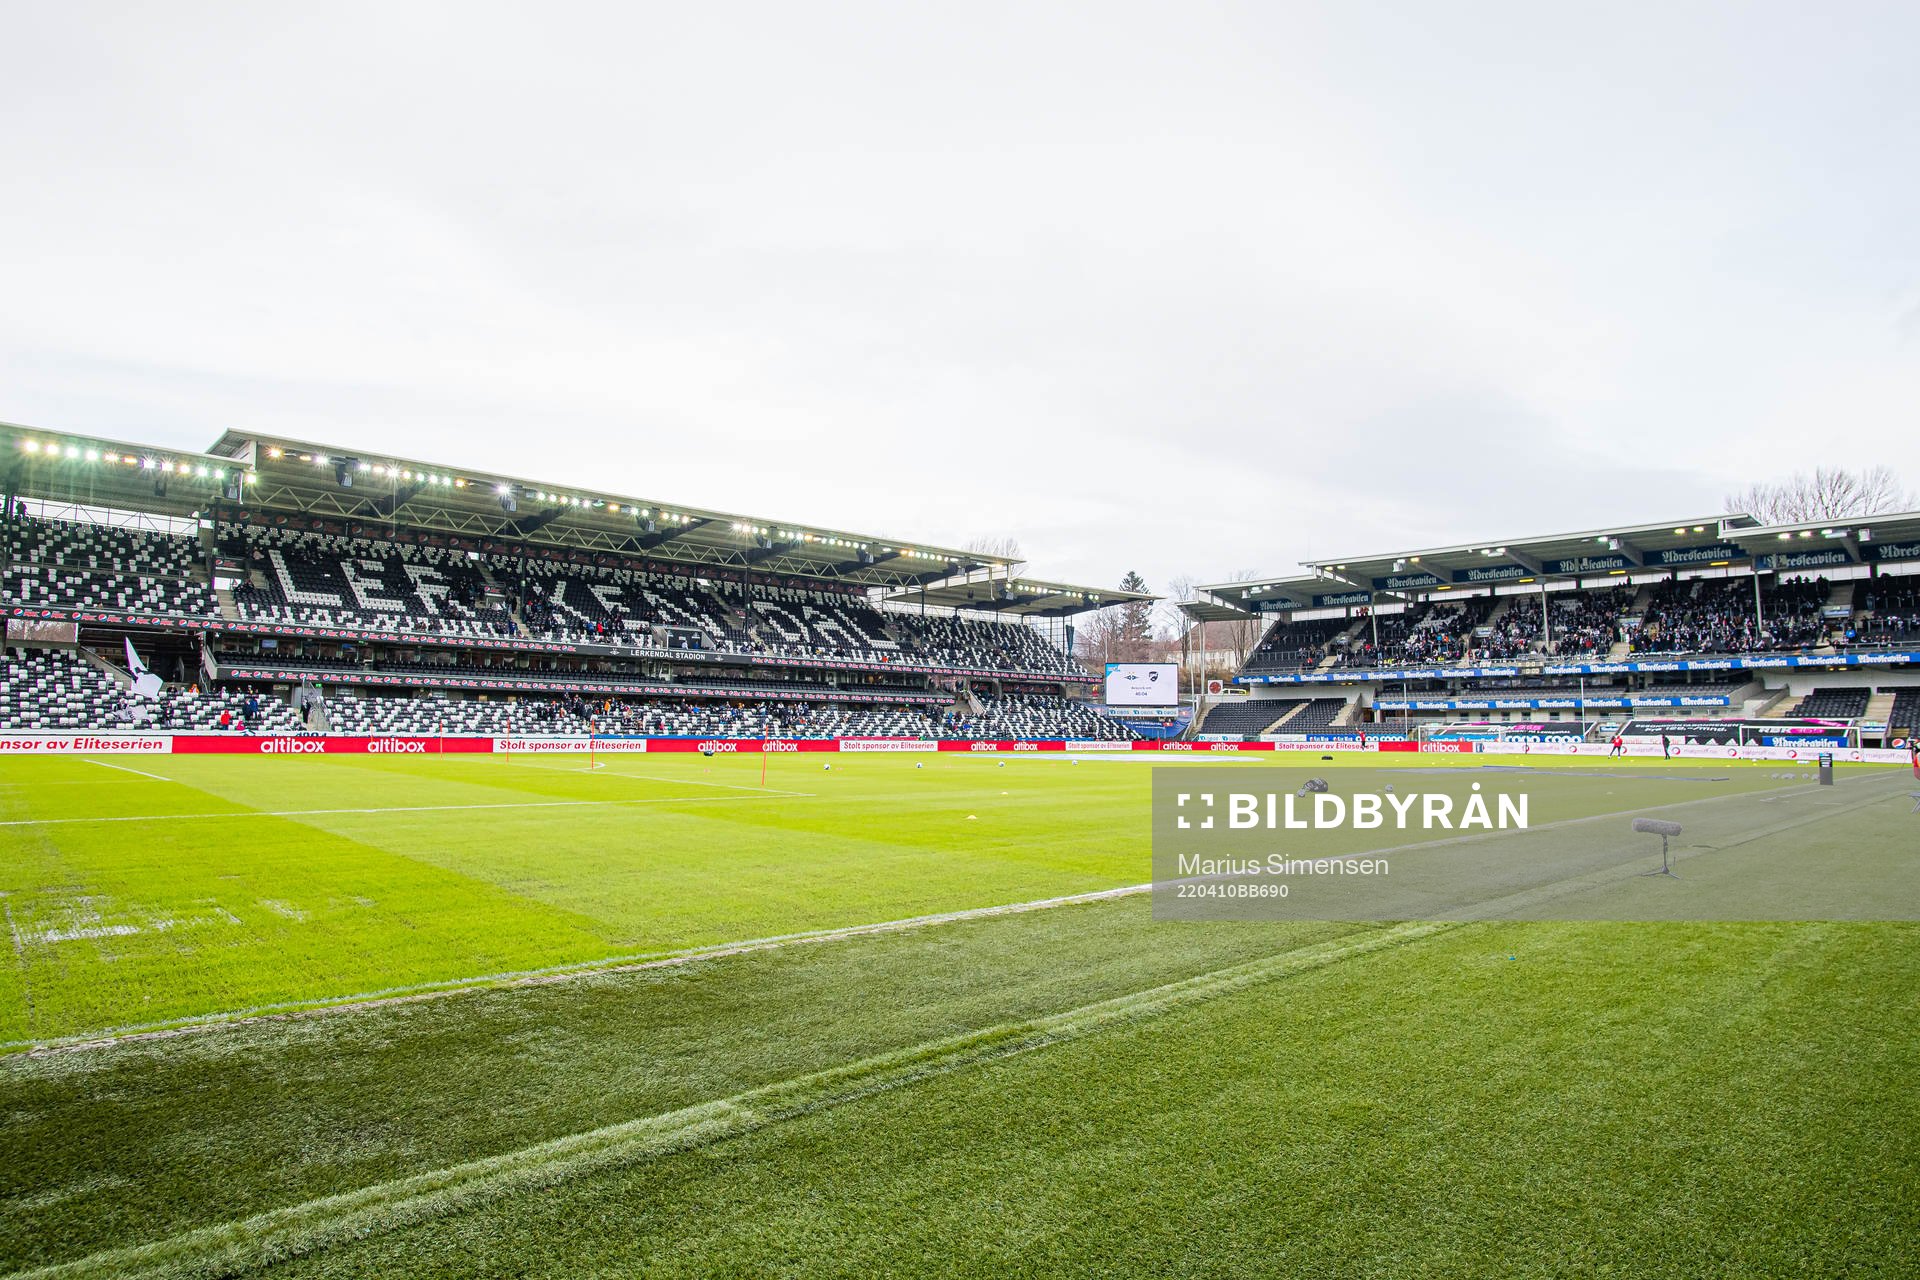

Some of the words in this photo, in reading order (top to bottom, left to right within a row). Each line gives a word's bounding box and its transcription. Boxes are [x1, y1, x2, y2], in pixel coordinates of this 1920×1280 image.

[630, 650, 674, 659] LERKENDAL
[675, 651, 706, 660] STADION
[46, 739, 68, 750] av
[73, 737, 163, 750] Eliteserien
[260, 737, 326, 753] altibox
[367, 737, 426, 753] altibox
[500, 740, 526, 750] Stolt
[529, 741, 571, 752] sponsor
[574, 742, 587, 750] av
[590, 740, 641, 750] Eliteserien
[697, 740, 738, 752] altibox
[762, 740, 799, 752] altibox
[843, 741, 861, 750] Stolt
[862, 742, 890, 752] sponsor
[891, 742, 900, 750] av
[901, 741, 935, 750] Eliteserien
[971, 741, 998, 751] altibox
[1013, 741, 1038, 751] altibox
[1163, 742, 1193, 751] altibox
[1210, 742, 1239, 752] altibox
[1298, 743, 1323, 751] sponsor
[1422, 742, 1460, 752] altibox
